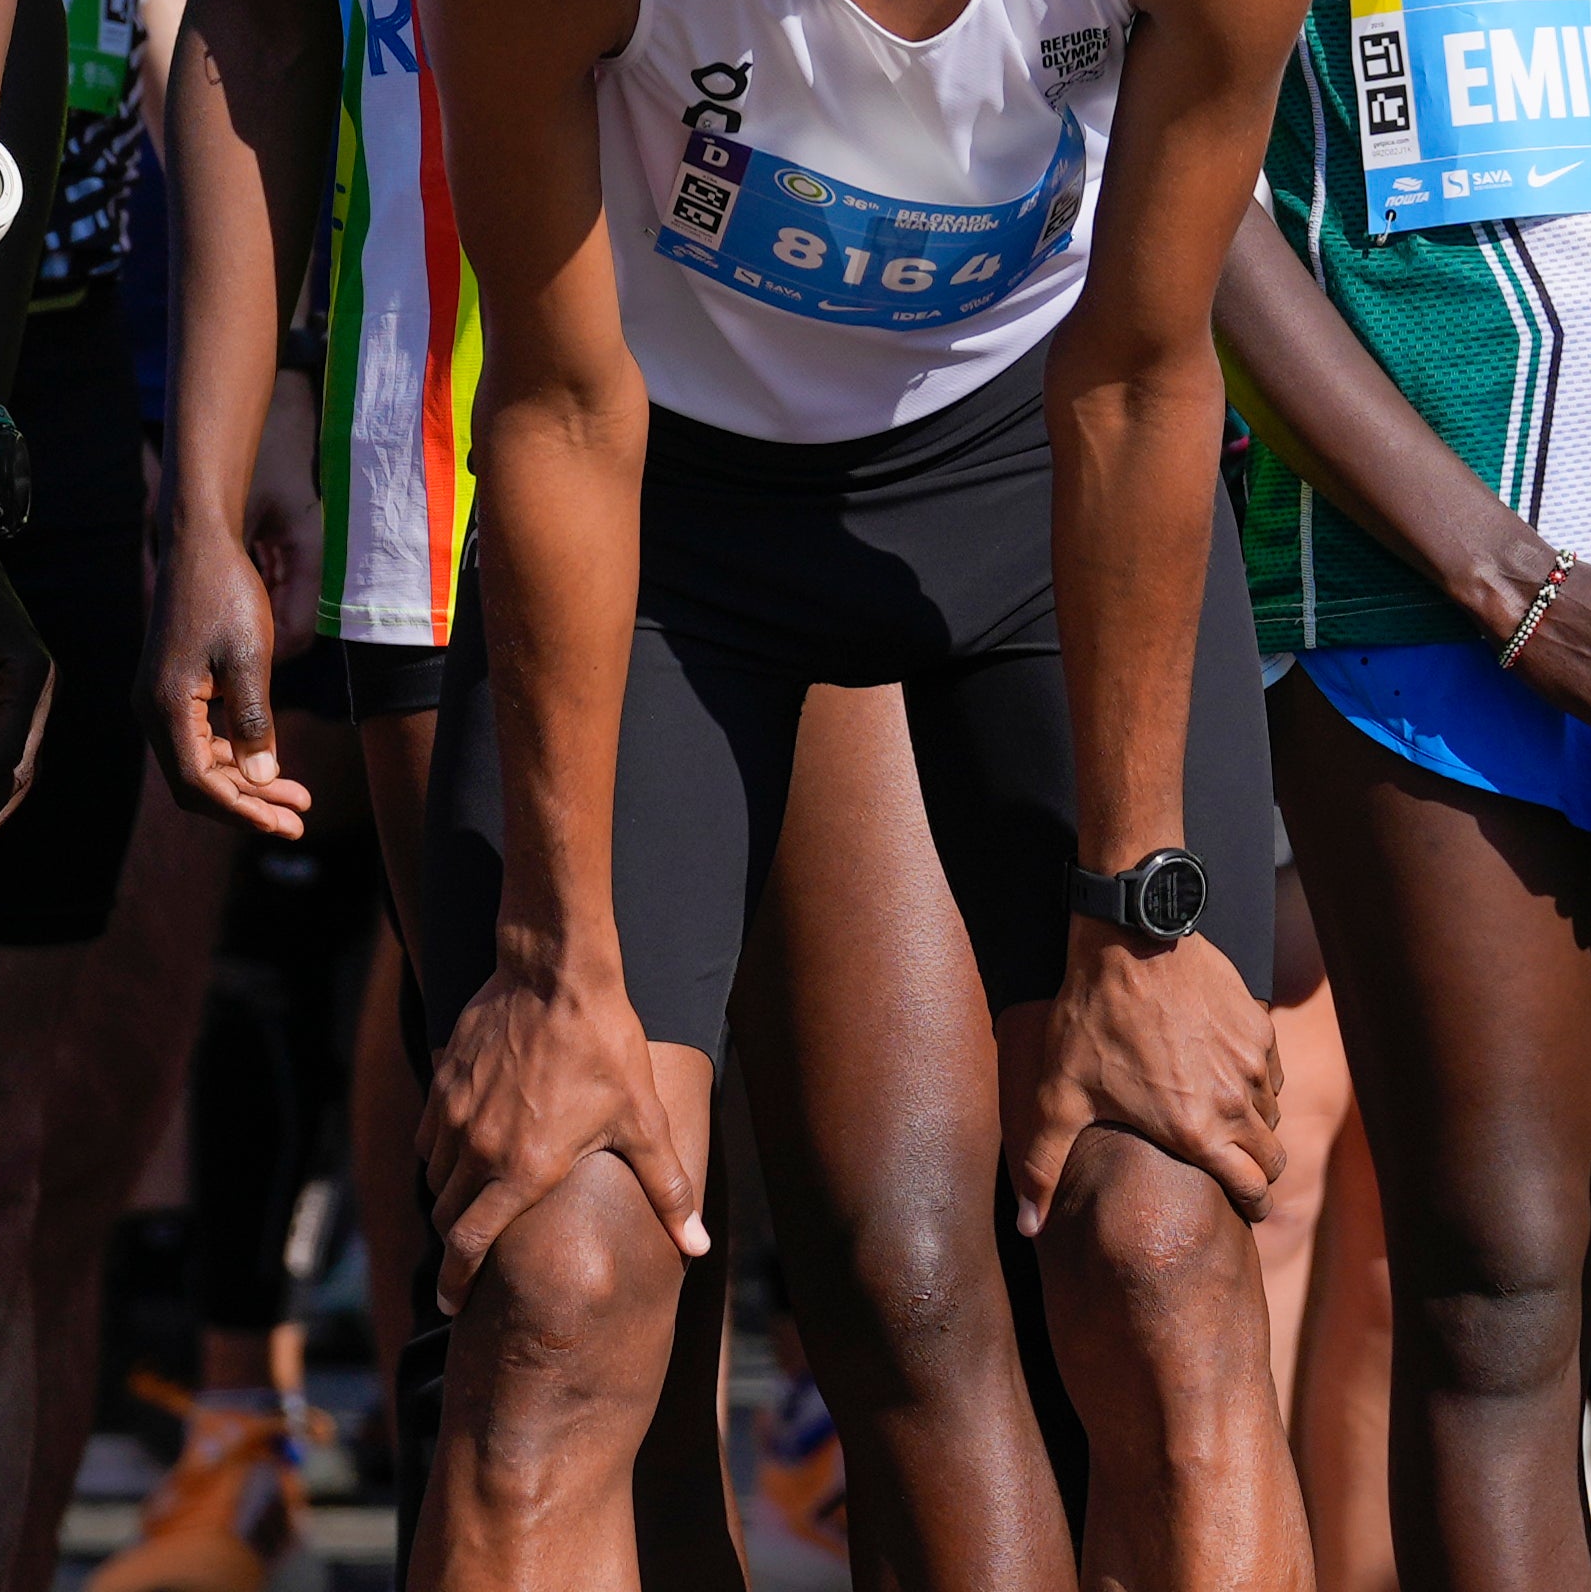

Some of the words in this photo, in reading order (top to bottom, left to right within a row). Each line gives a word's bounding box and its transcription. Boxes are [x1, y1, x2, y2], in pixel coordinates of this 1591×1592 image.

[1040, 26, 1110, 54] REFUGEE
[1042, 38, 1110, 68] OLYMPIC
[1056, 51, 1099, 78] TEAM
[702, 137, 730, 168] D
[1472, 169, 1513, 186] SAVA
[842, 195, 879, 211] 36th
[896, 209, 993, 224] BELGRADE
[1385, 191, 1430, 207] ПОШТА
[894, 219, 1000, 233] MARATHON
[773, 227, 1002, 293] 8164
[765, 280, 802, 300] SAVA
[892, 310, 942, 321] IDEA
